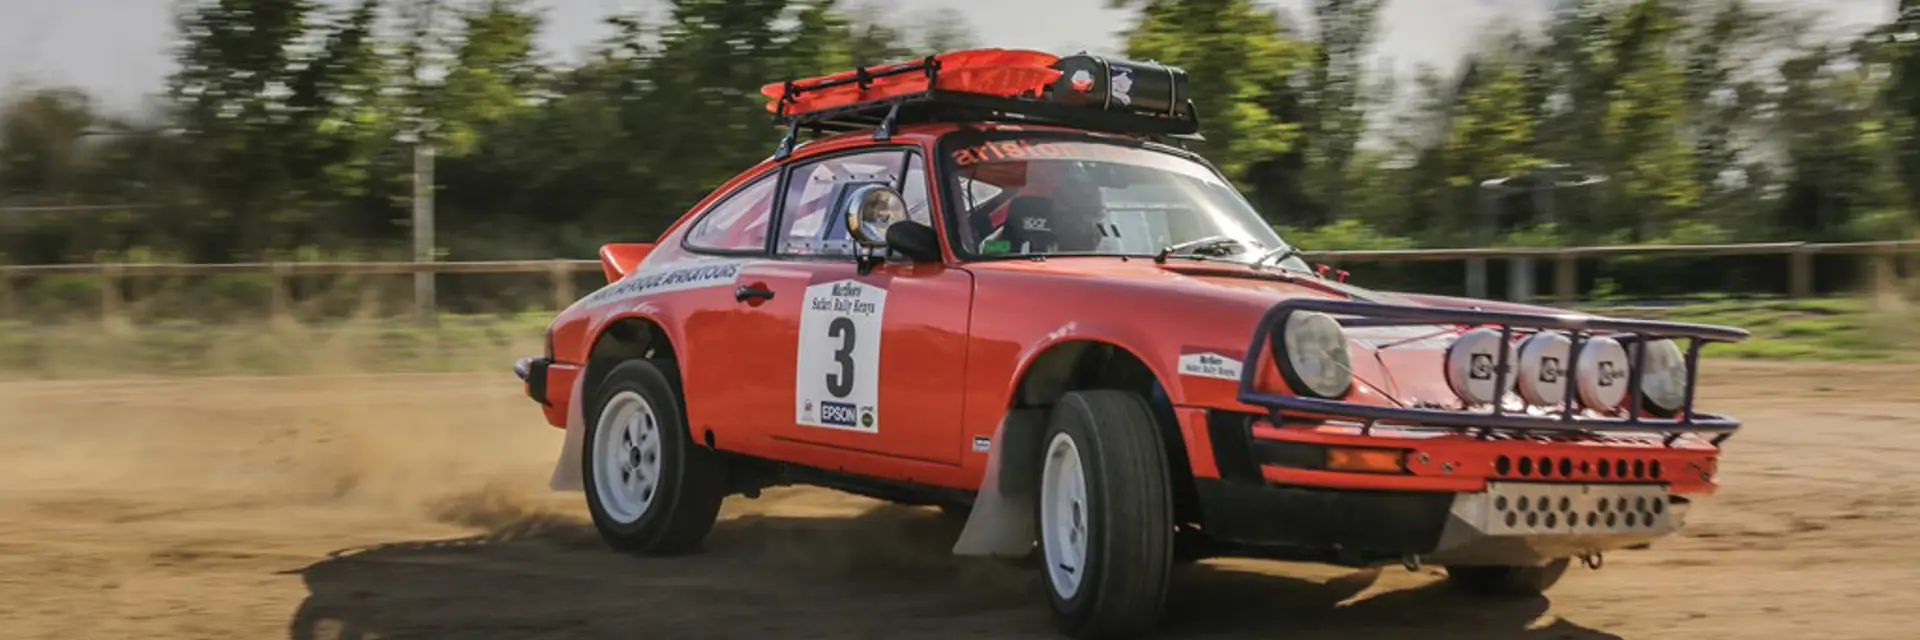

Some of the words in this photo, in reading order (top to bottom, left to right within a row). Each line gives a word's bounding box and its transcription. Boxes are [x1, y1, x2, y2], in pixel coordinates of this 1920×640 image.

[811, 298, 833, 312] Safari
[834, 298, 853, 315] Rally
[853, 300, 876, 316] Kenya
[826, 316, 856, 398] 3
[822, 405, 856, 422] EPSON
